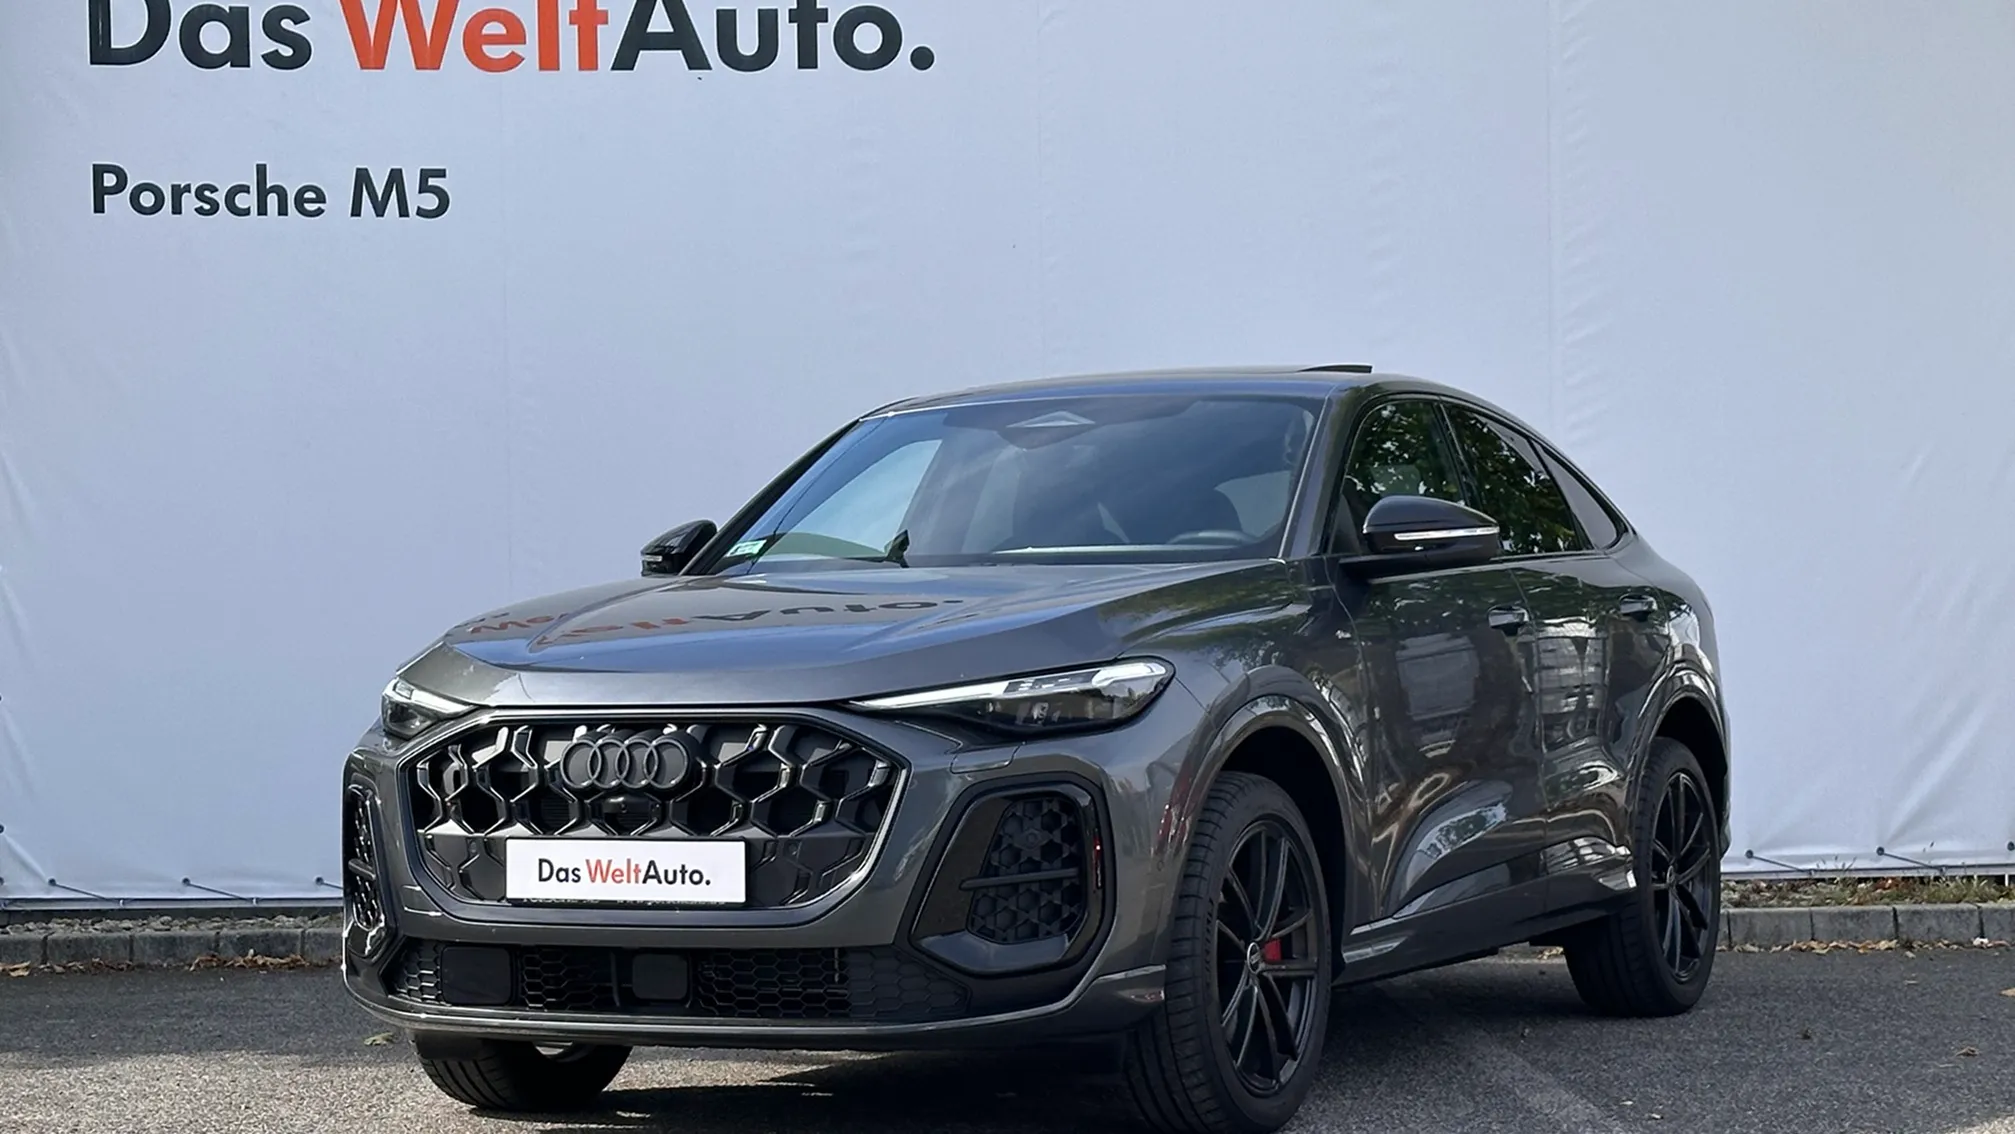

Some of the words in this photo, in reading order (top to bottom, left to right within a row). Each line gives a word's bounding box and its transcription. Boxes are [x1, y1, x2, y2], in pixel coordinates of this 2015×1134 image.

[89, 0, 313, 70] Das
[341, 0, 935, 72] WeltAuto.
[92, 163, 326, 217] Porsche
[350, 167, 451, 220] M5
[538, 858, 582, 883] Das
[586, 858, 712, 886] WeltAuto.
